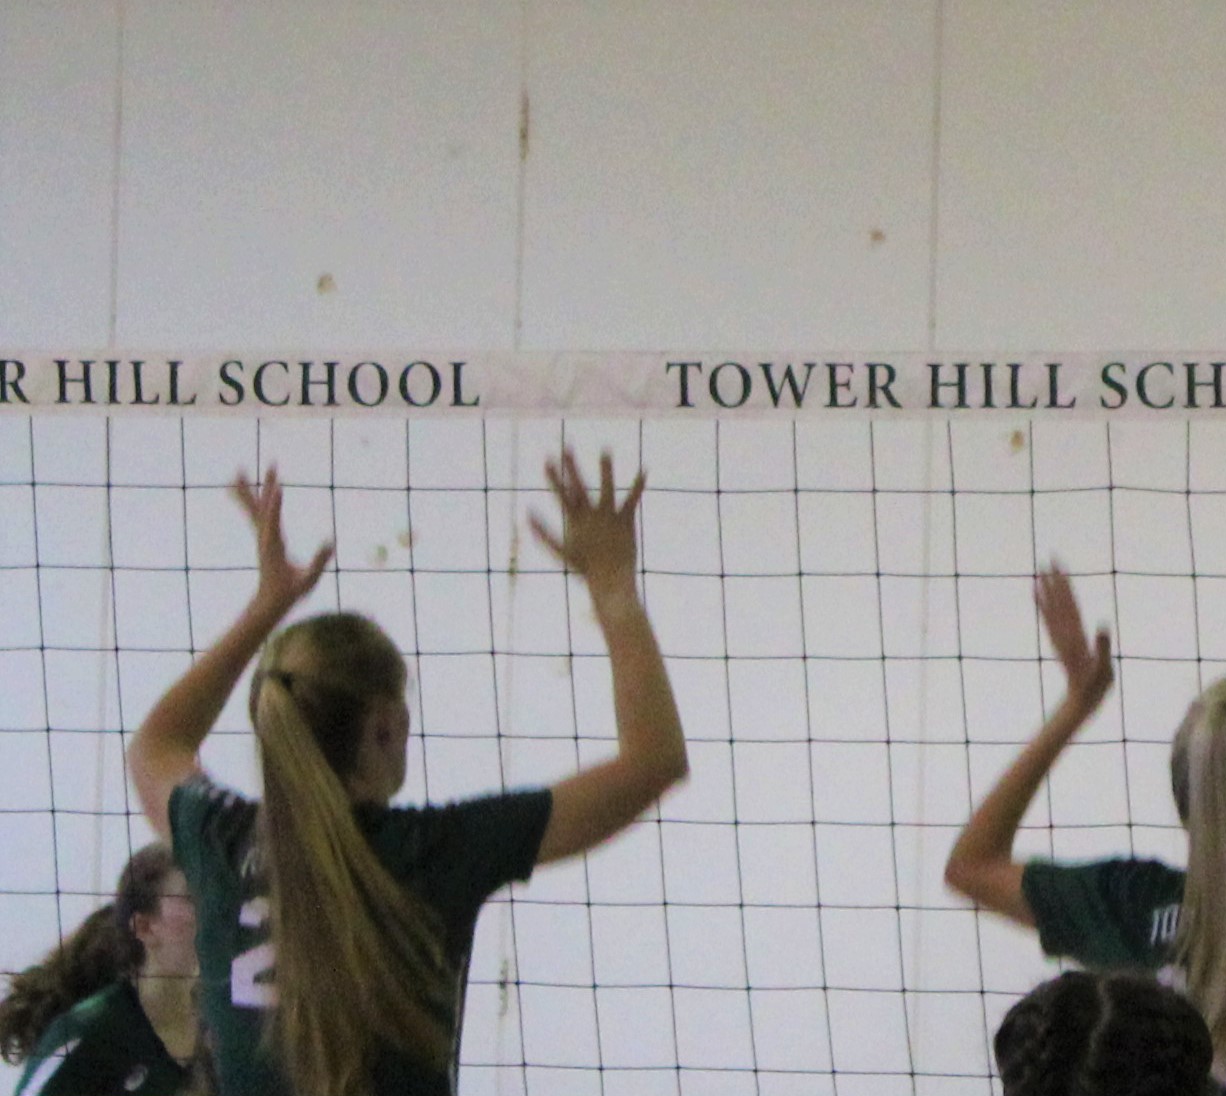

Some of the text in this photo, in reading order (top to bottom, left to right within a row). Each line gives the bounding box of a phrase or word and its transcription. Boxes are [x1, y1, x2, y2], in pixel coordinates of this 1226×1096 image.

[53, 359, 198, 406] HILL
[218, 360, 481, 408] SCHOOL
[665, 361, 903, 409] TOWER
[926, 361, 1077, 410] HILL
